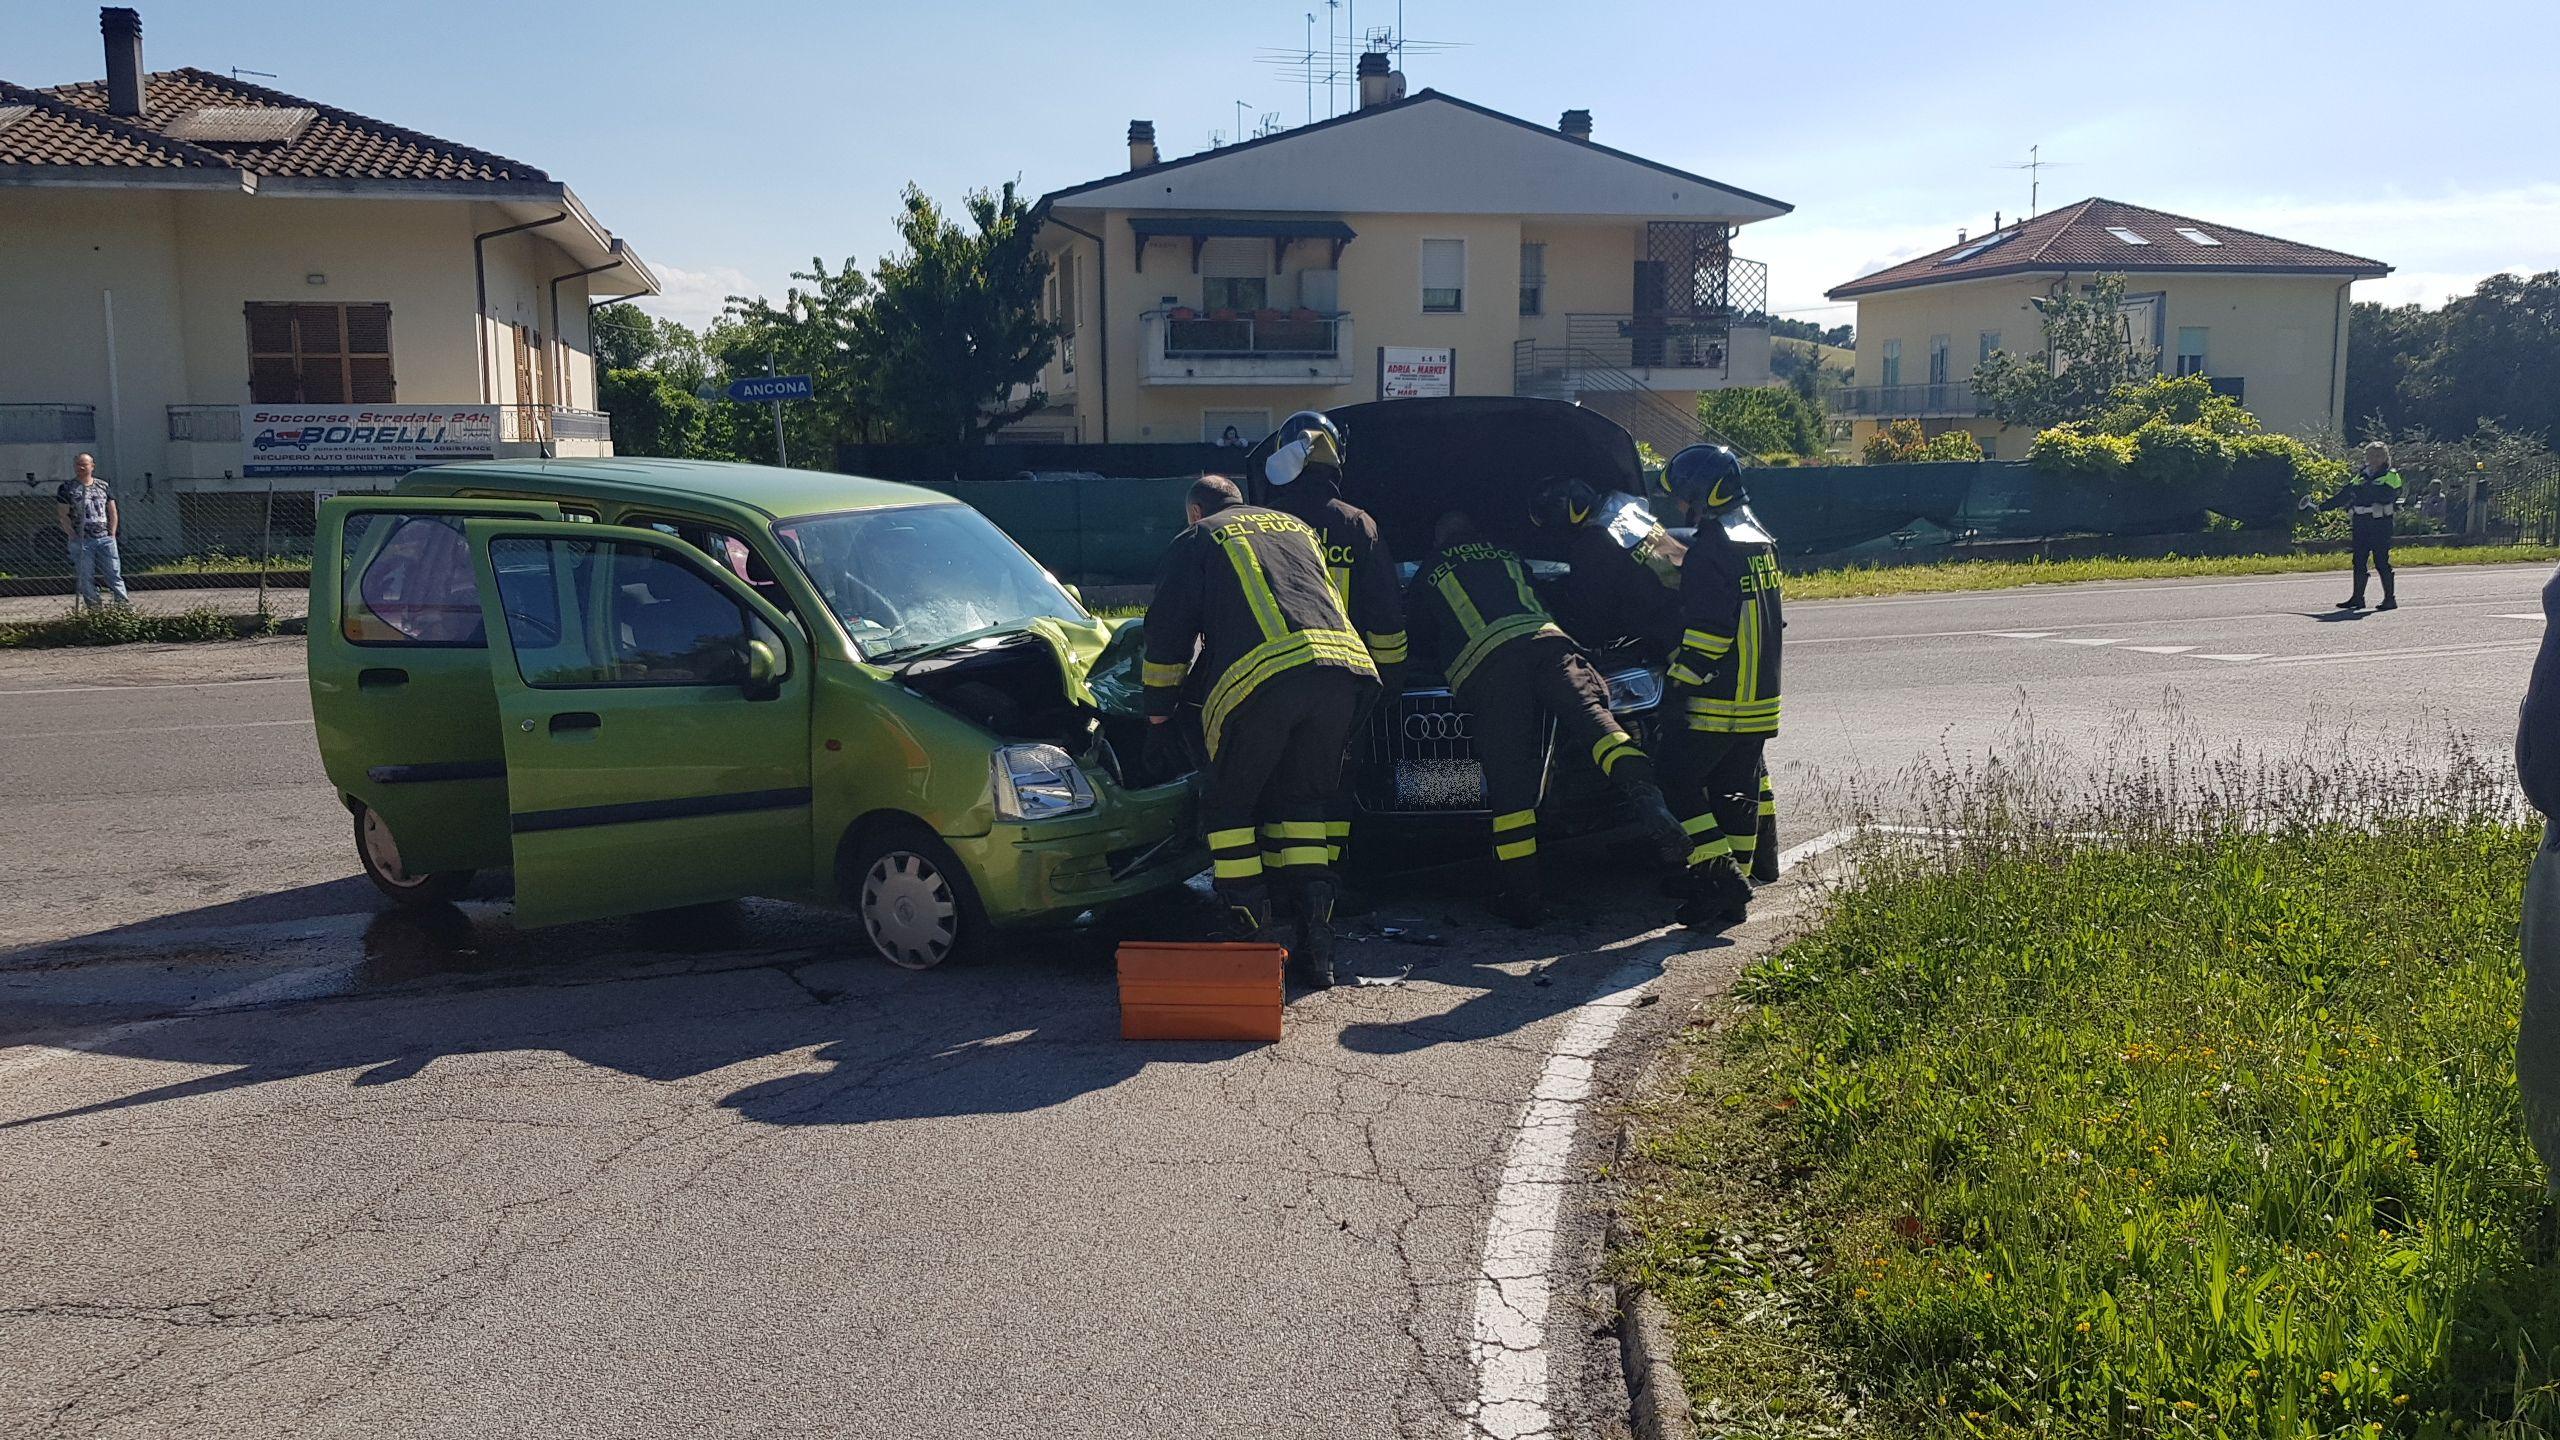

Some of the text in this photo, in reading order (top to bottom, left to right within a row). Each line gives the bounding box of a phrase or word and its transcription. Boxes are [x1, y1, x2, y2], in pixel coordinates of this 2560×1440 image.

[1388, 365, 1410, 373] ADRIA
[1418, 365, 1447, 374] MARKET
[743, 381, 807, 397] ANCONA
[253, 412, 490, 423] Soccorso Stradale 24h
[298, 426, 447, 444] BORELLI
[1230, 512, 1292, 523] VIGILI
[1211, 521, 1255, 545] DEL
[1441, 542, 1494, 558] VIGILI
[1427, 560, 1458, 586] DEL
